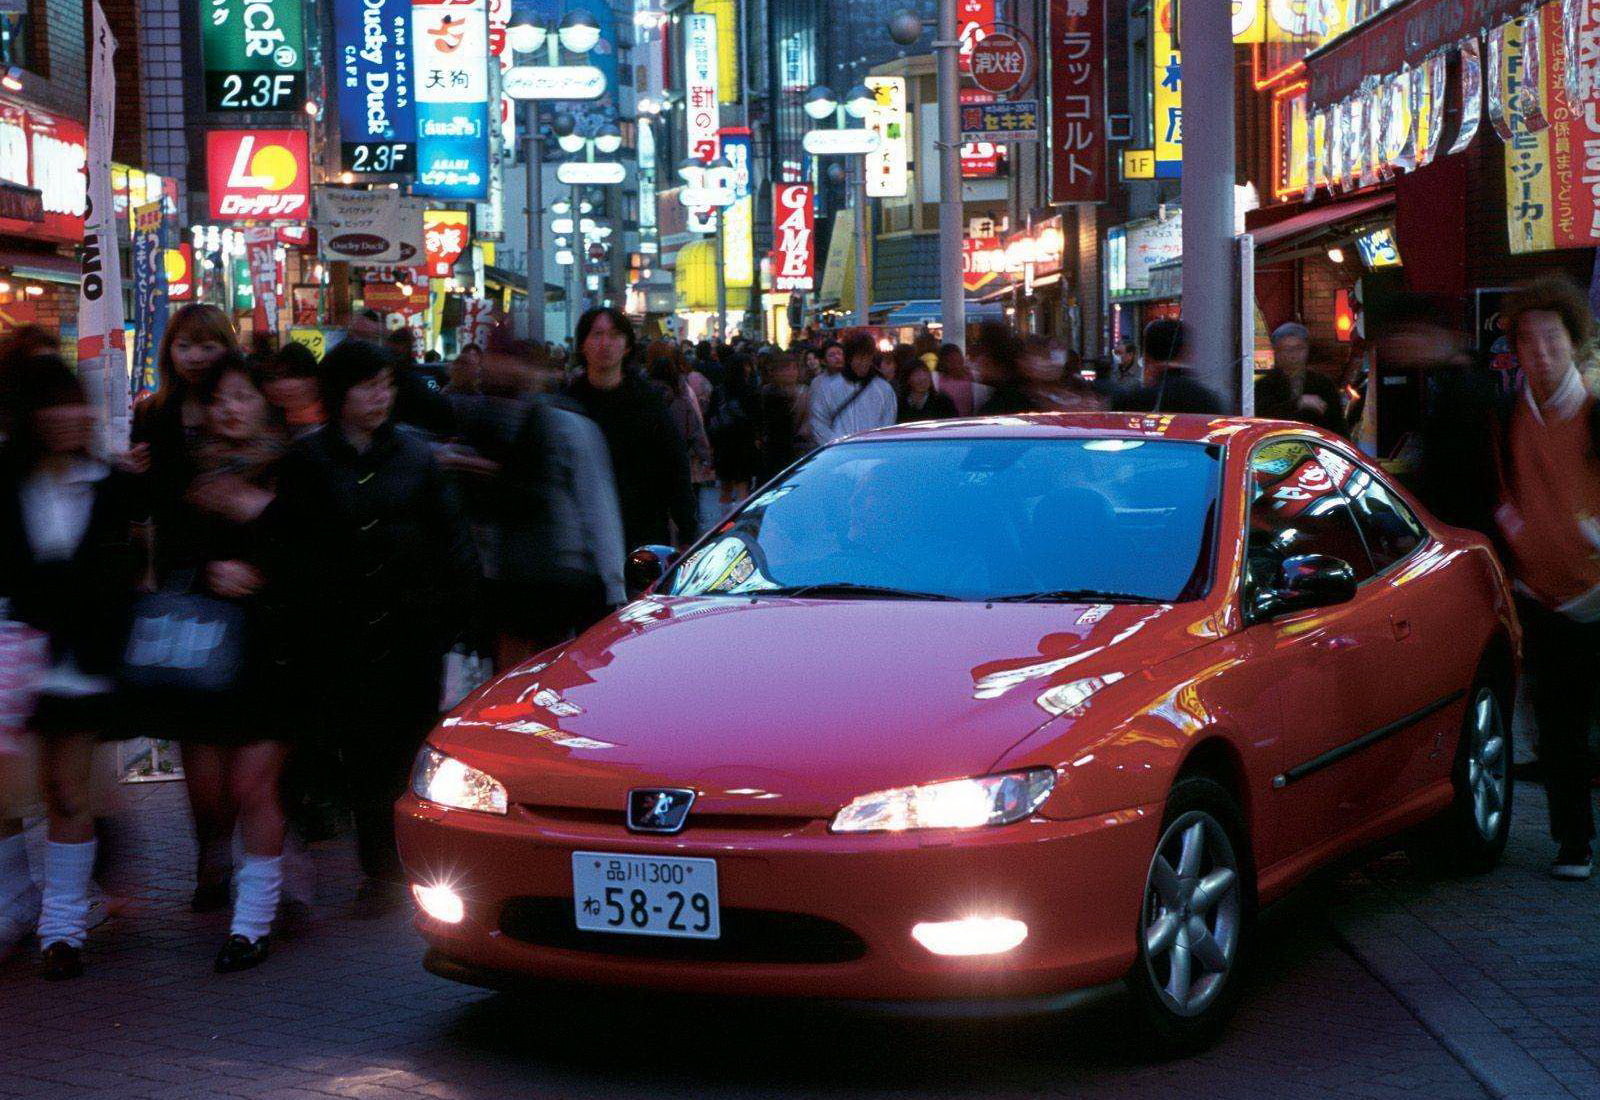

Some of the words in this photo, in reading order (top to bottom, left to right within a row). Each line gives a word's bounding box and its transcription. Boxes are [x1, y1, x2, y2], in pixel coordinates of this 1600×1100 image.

[244, 0, 285, 57] ck
[345, 45, 358, 88] CAFE
[425, 69, 471, 89] 天狗
[975, 52, 1022, 74] 消火栓
[220, 74, 295, 107] 2.3F
[366, 71, 390, 136] Duck
[984, 112, 1036, 132] セキネ
[1063, 31, 1095, 184] ラッコルト
[352, 144, 408, 172] 2.3F
[1129, 156, 1148, 173] 1F
[219, 194, 305, 215] ロッテリア
[777, 185, 811, 277] GAME
[582, 895, 601, 917] ね
[605, 887, 711, 932] 58-29
